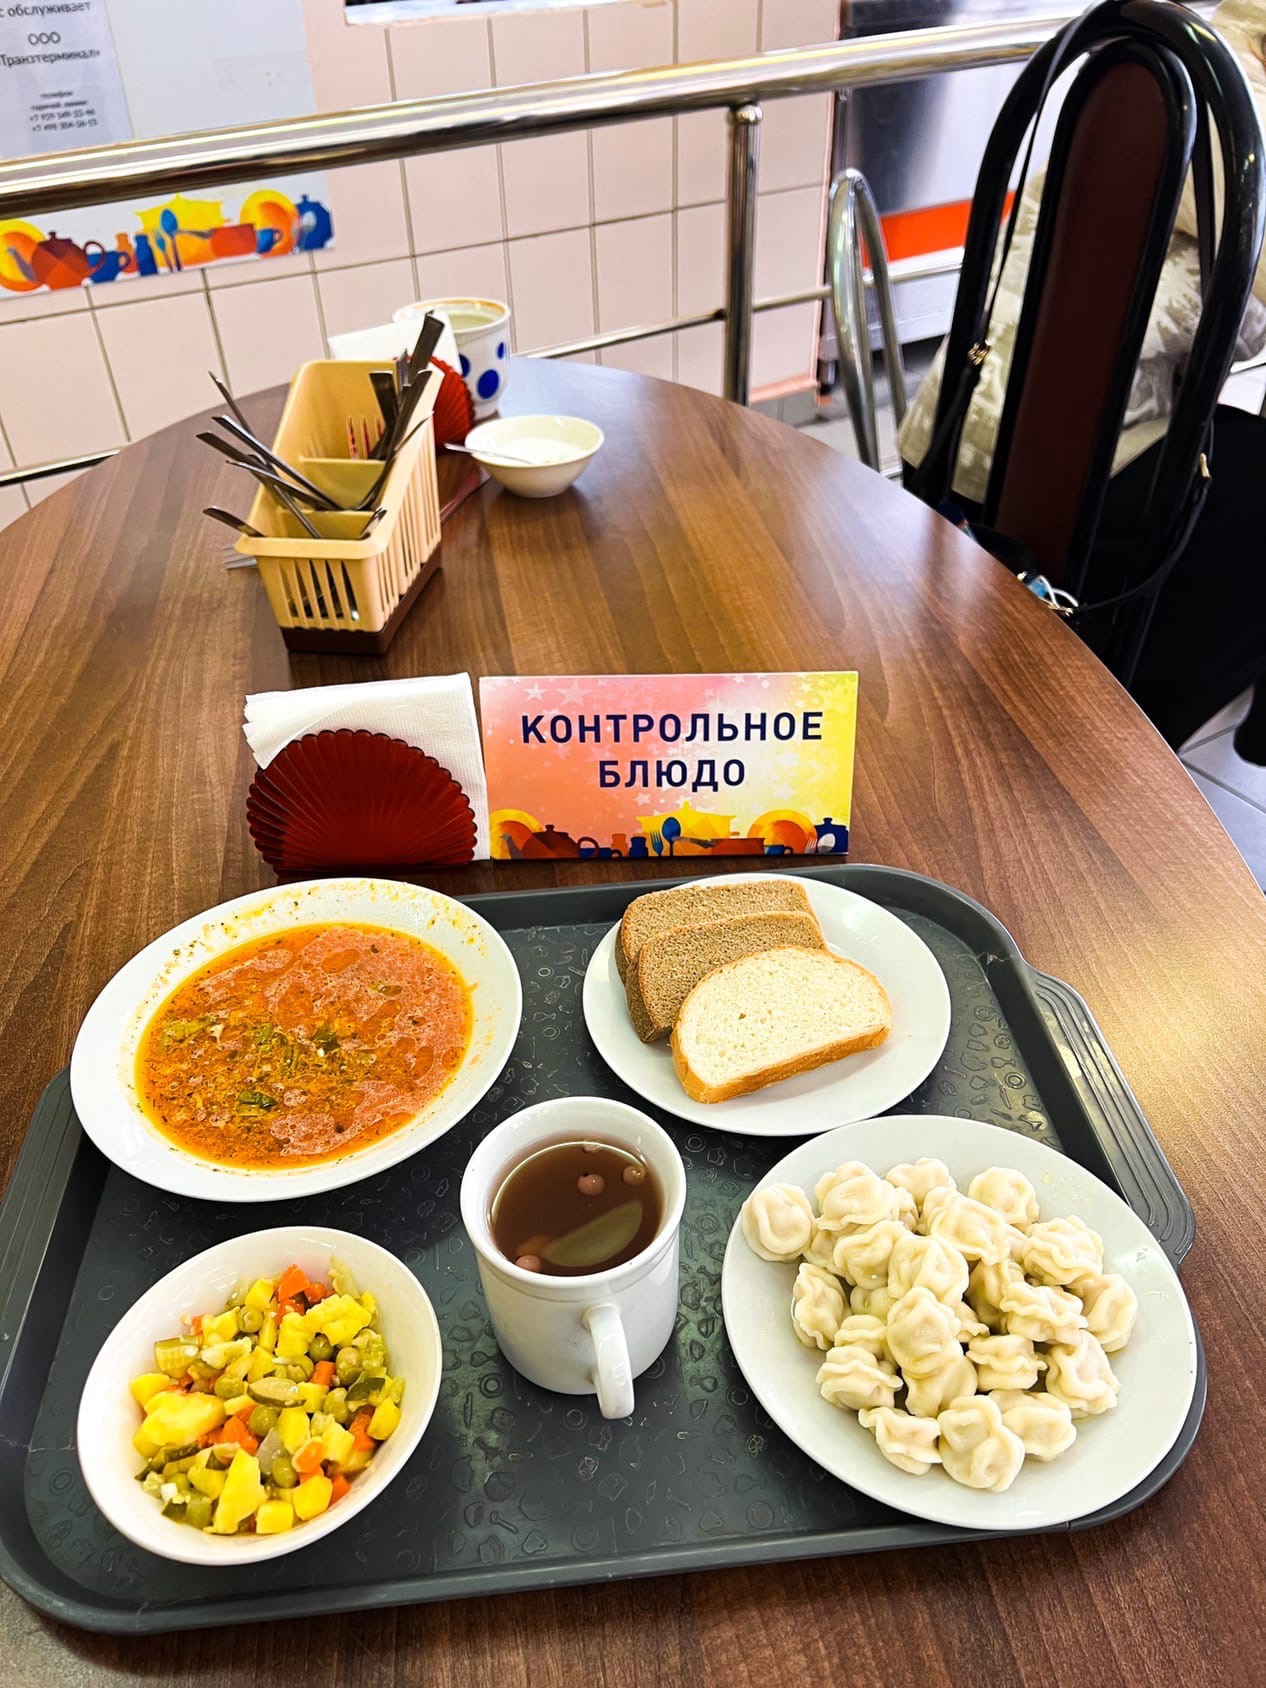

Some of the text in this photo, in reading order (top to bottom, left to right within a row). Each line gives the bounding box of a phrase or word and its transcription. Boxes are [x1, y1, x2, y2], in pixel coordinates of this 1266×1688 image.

[8, 1, 91, 17] обслуживает
[28, 31, 61, 46] ООО
[521, 711, 824, 744] КОНТРОЛЬНОЕ
[599, 758, 745, 792] БЛЮДО
